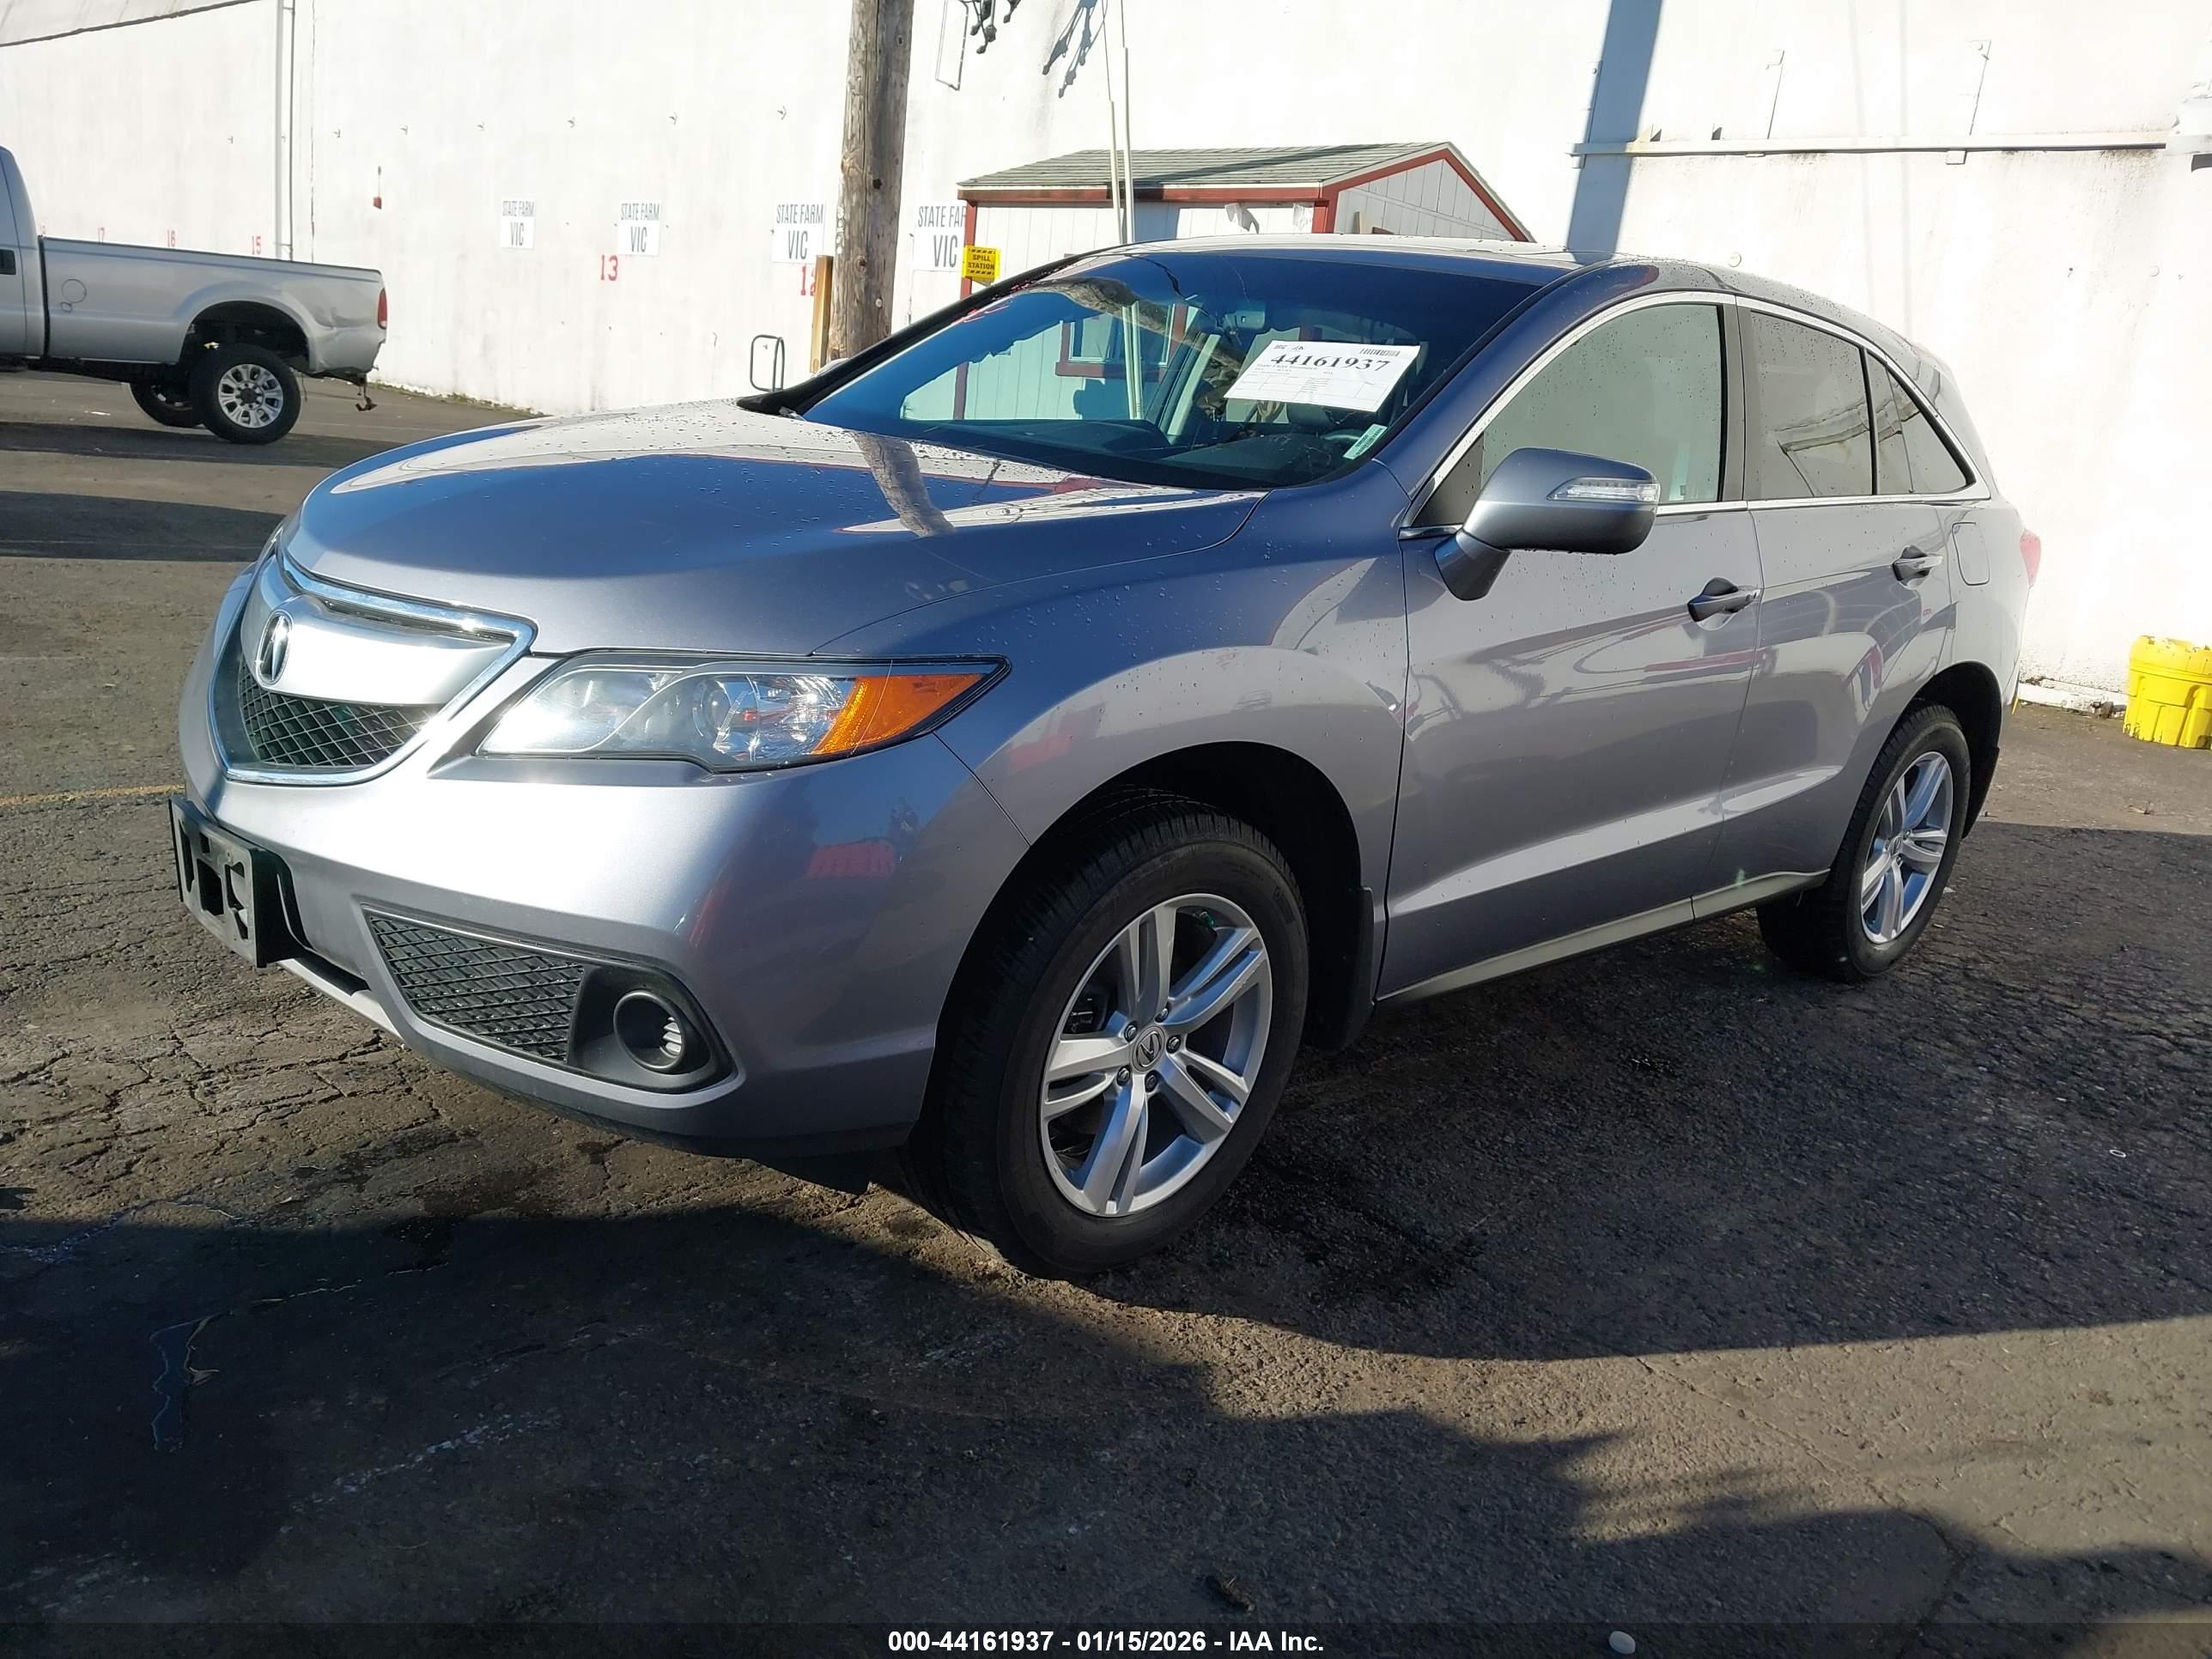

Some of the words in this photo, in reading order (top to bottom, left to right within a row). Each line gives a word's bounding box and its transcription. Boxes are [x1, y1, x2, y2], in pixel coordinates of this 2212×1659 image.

[620, 203, 640, 221] STATE
[640, 203, 659, 222] FARM
[775, 204, 799, 225] STATE
[799, 204, 824, 225] FARM
[917, 205, 947, 228] STATE
[948, 206, 966, 228] FAR
[252, 235, 262, 255] 15
[510, 222, 525, 246] VIC
[630, 225, 647, 253] VIC
[787, 230, 808, 260] VIC
[933, 234, 957, 268] VIC
[599, 254, 619, 281] 13
[1271, 353, 1391, 372] 44161937
